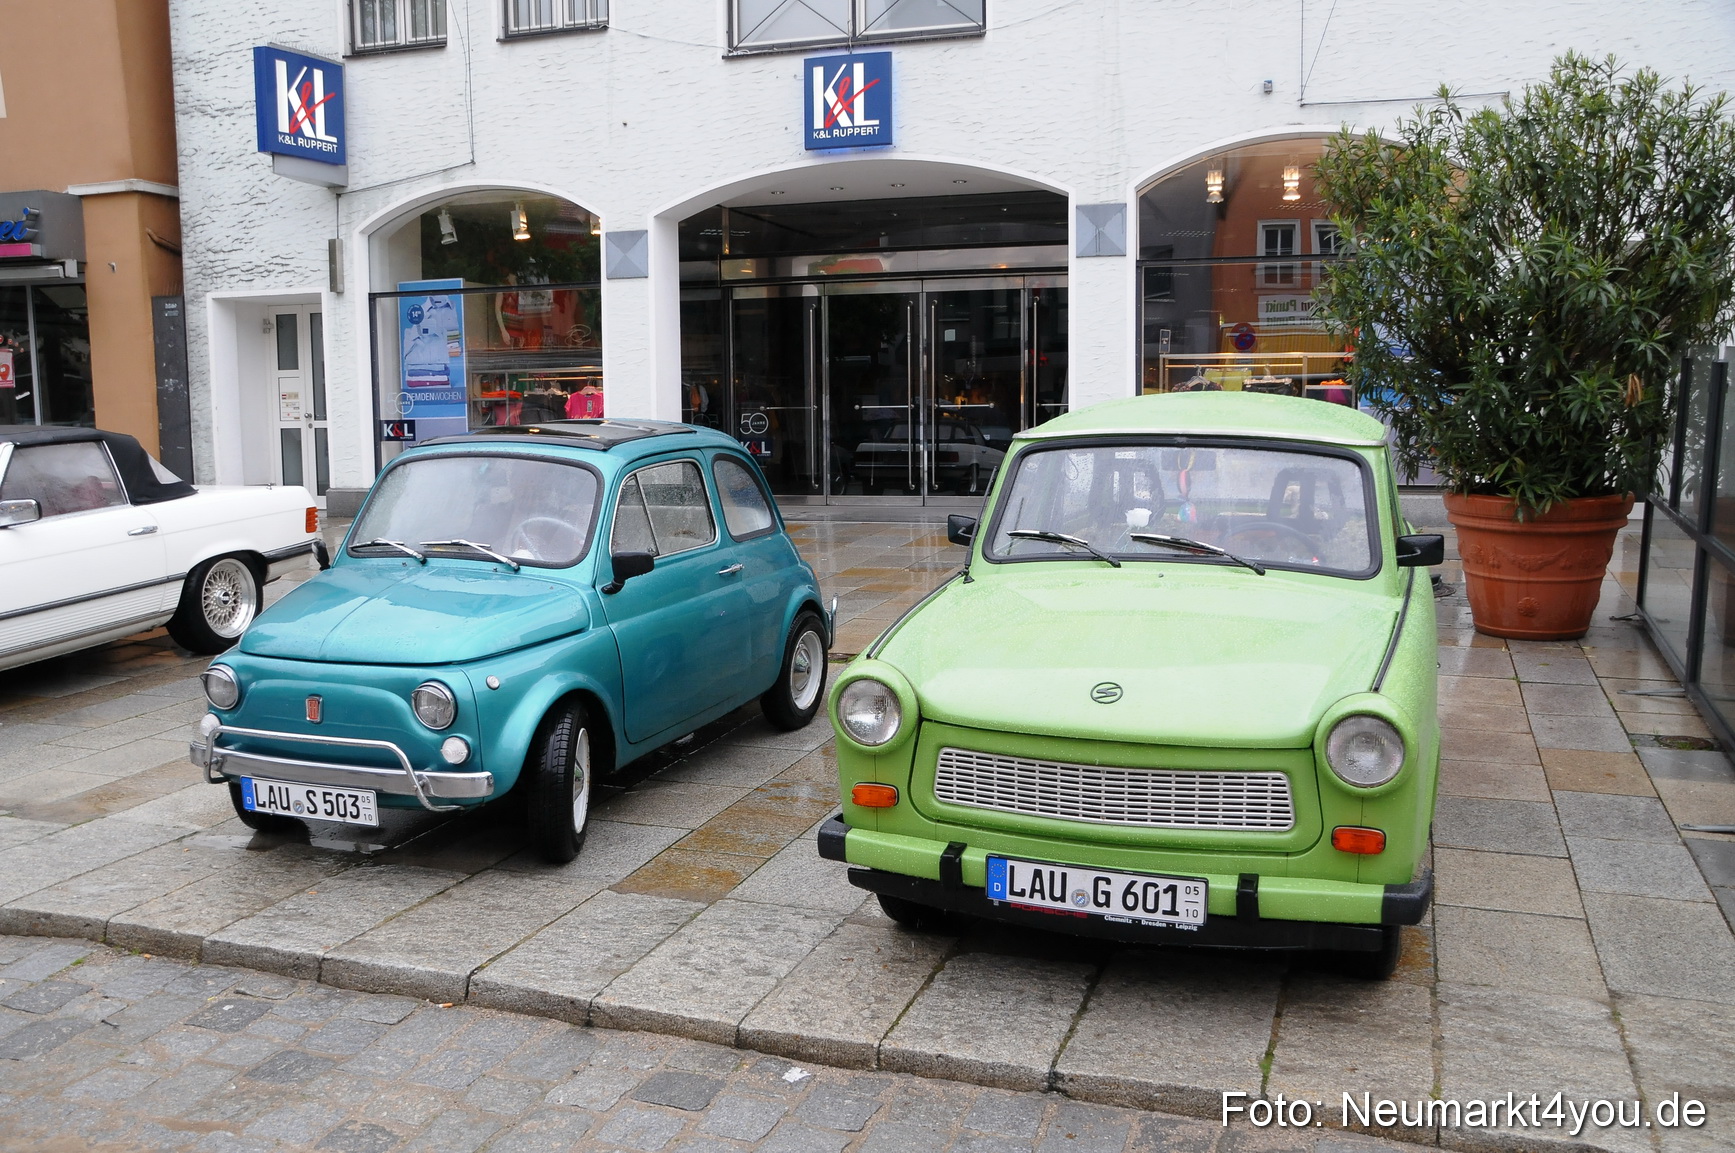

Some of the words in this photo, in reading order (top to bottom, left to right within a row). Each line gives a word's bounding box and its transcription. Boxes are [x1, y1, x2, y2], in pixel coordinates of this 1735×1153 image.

[275, 59, 337, 143] K&L
[813, 62, 881, 130] K&L
[813, 131, 831, 139] K&L
[833, 126, 880, 138] RUPPERT
[278, 134, 297, 146] K&L
[298, 137, 338, 154] RUPPERT
[383, 422, 414, 437] K&L
[740, 412, 769, 435] 50
[247, 796, 252, 804] D
[254, 783, 291, 811] LAU
[306, 789, 318, 815] S
[322, 791, 361, 819] 503
[361, 795, 371, 804] 05
[363, 813, 373, 822] 10
[993, 882, 1001, 892] D
[1009, 864, 1068, 903] LAU
[1092, 876, 1112, 909] G
[1122, 880, 1180, 917] 601
[1185, 885, 1200, 896] 05
[1185, 908, 1199, 919] 10
[1104, 914, 1132, 924] Chemnitz
[1141, 919, 1166, 928] Dresden
[1175, 923, 1198, 931] Leipzig
